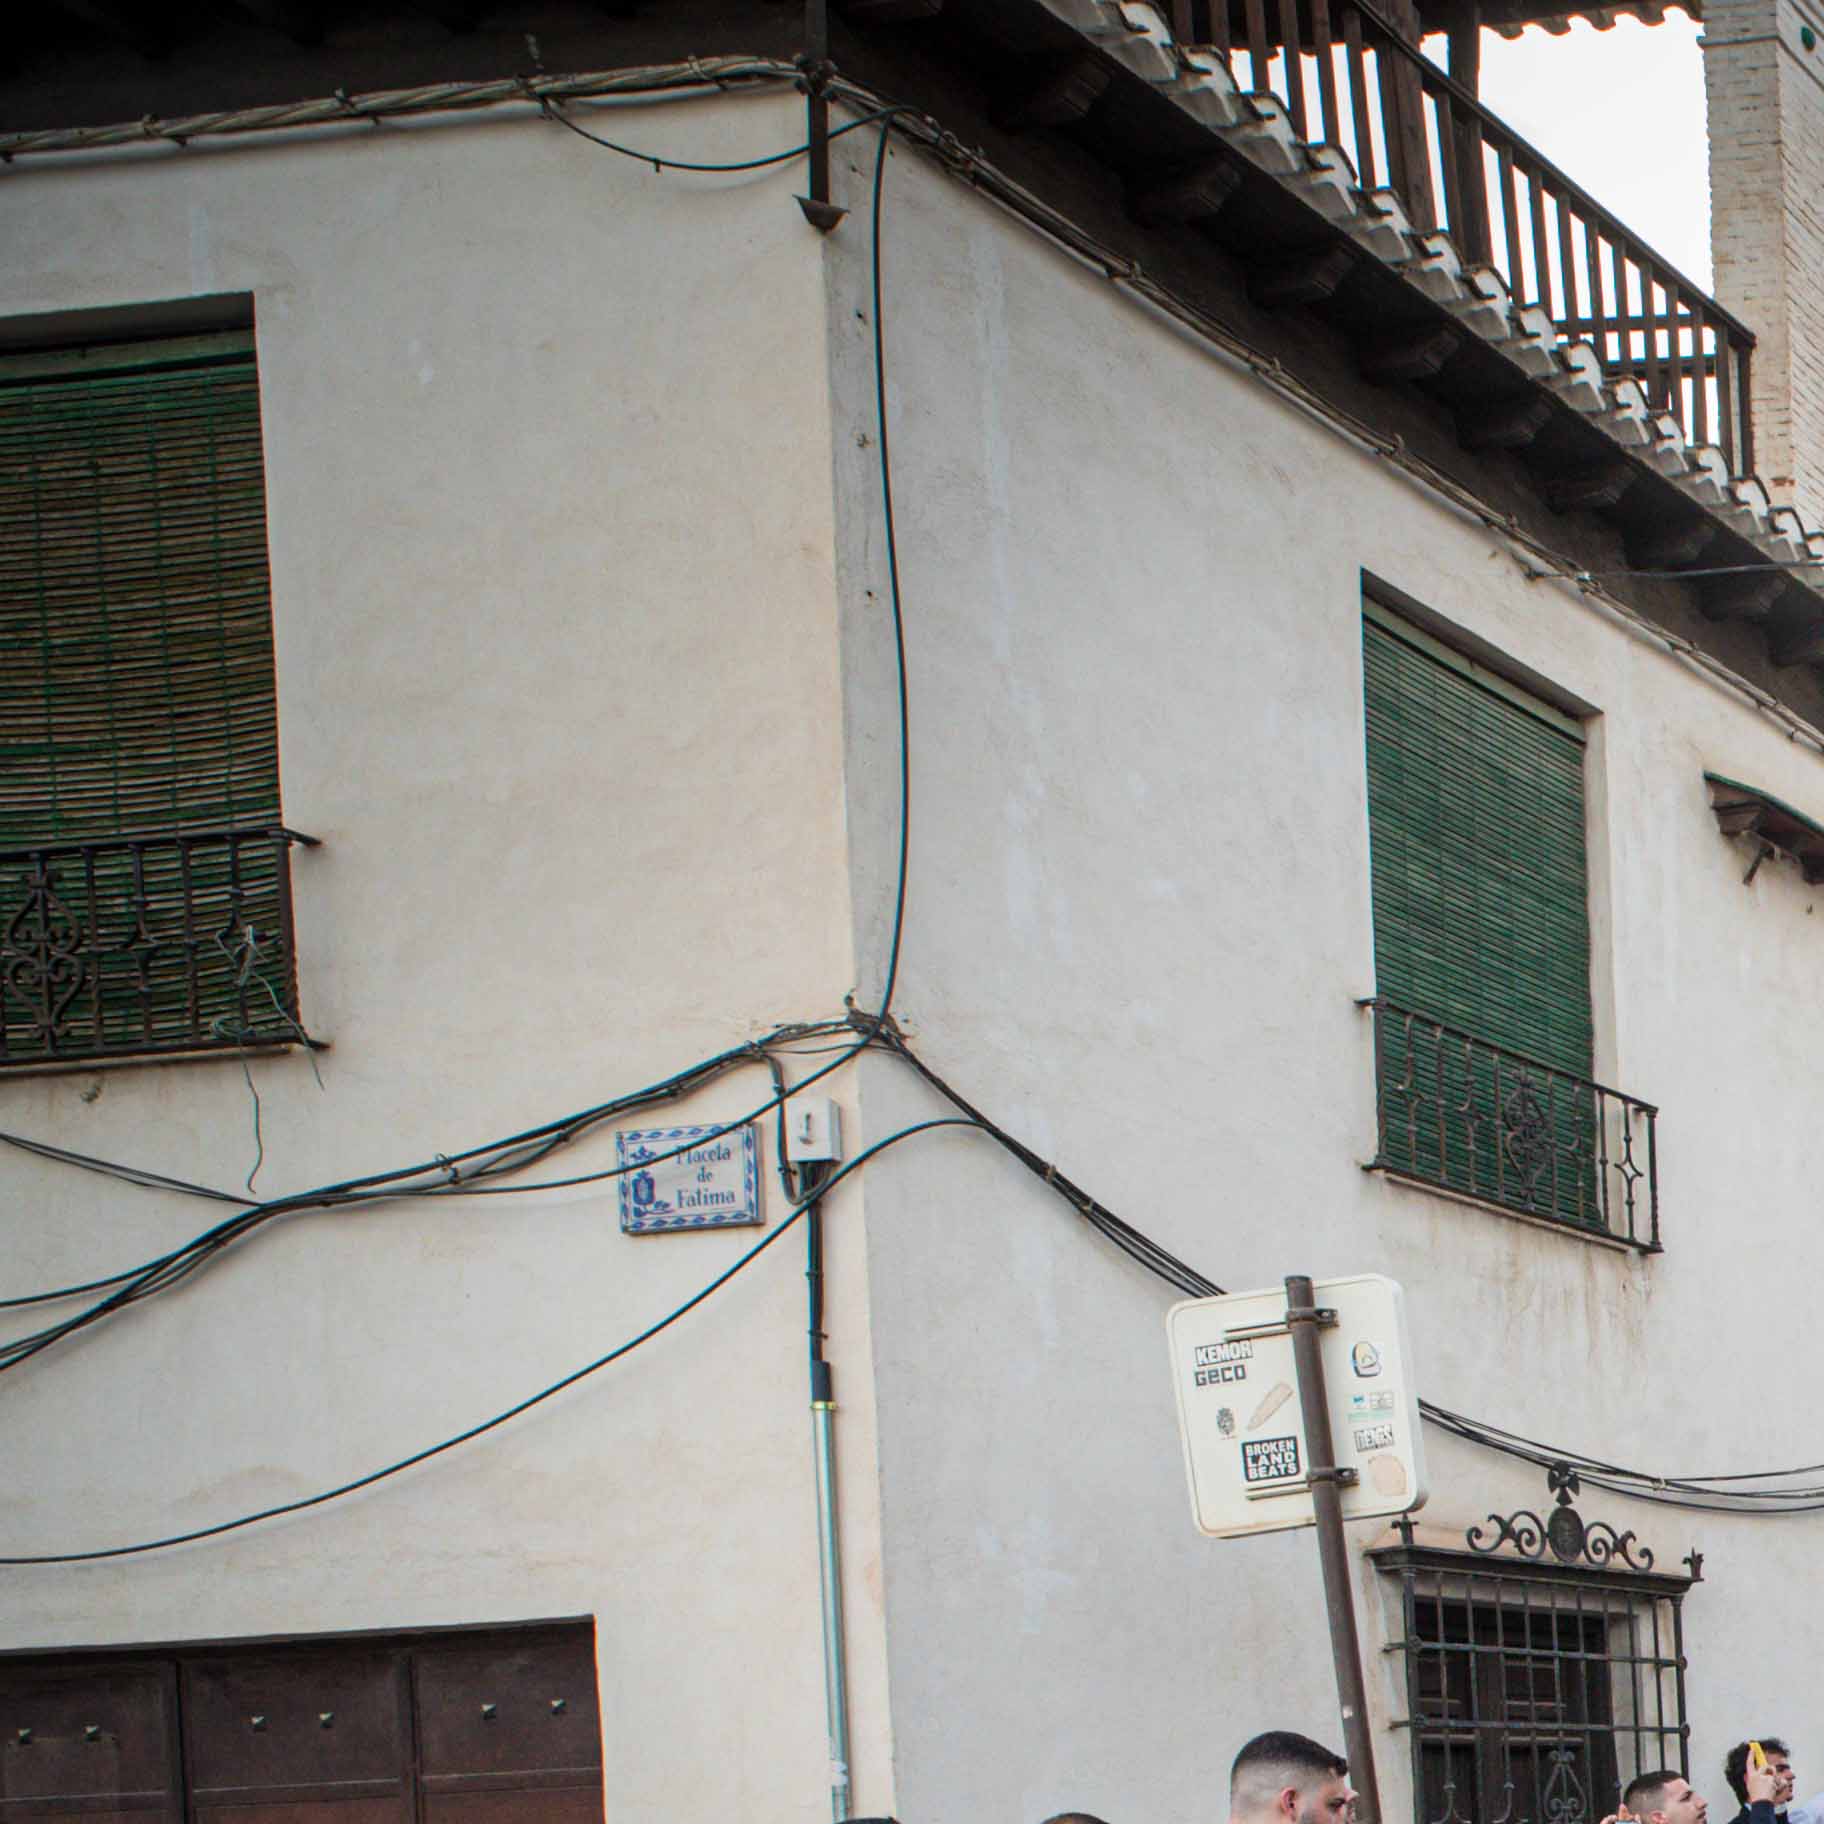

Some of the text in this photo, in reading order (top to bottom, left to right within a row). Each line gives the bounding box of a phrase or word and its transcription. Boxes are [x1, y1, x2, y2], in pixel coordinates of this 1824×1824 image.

[697, 1166, 713, 1183] de
[1245, 1440, 1295, 1456] BROKEN
[1247, 1452, 1295, 1467] LAND
[1248, 1463, 1297, 1479] BEATS
